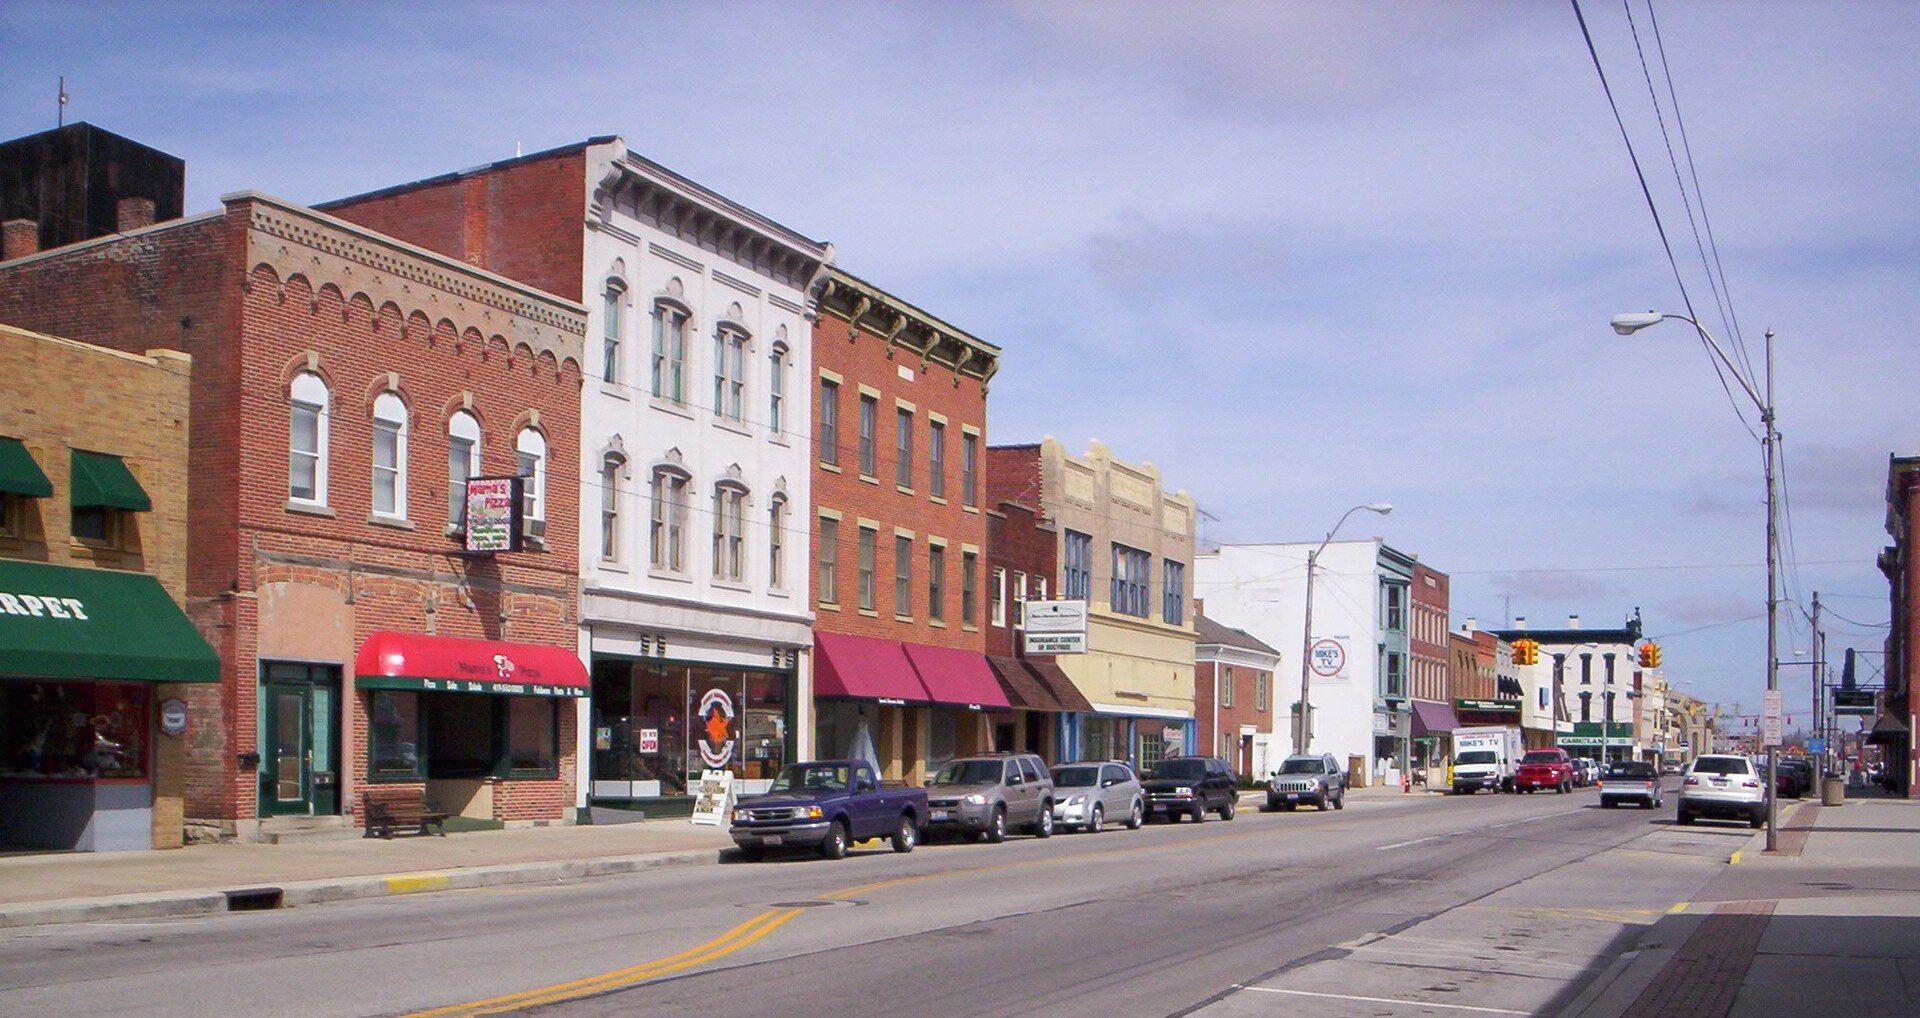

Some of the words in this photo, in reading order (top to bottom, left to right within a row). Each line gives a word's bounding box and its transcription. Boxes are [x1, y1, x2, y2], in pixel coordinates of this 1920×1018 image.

[0, 592, 89, 620] RPET
[1315, 649, 1339, 658] MIKE'S
[1459, 739, 1484, 747] MIKE'S
[1489, 738, 1500, 746] TV
